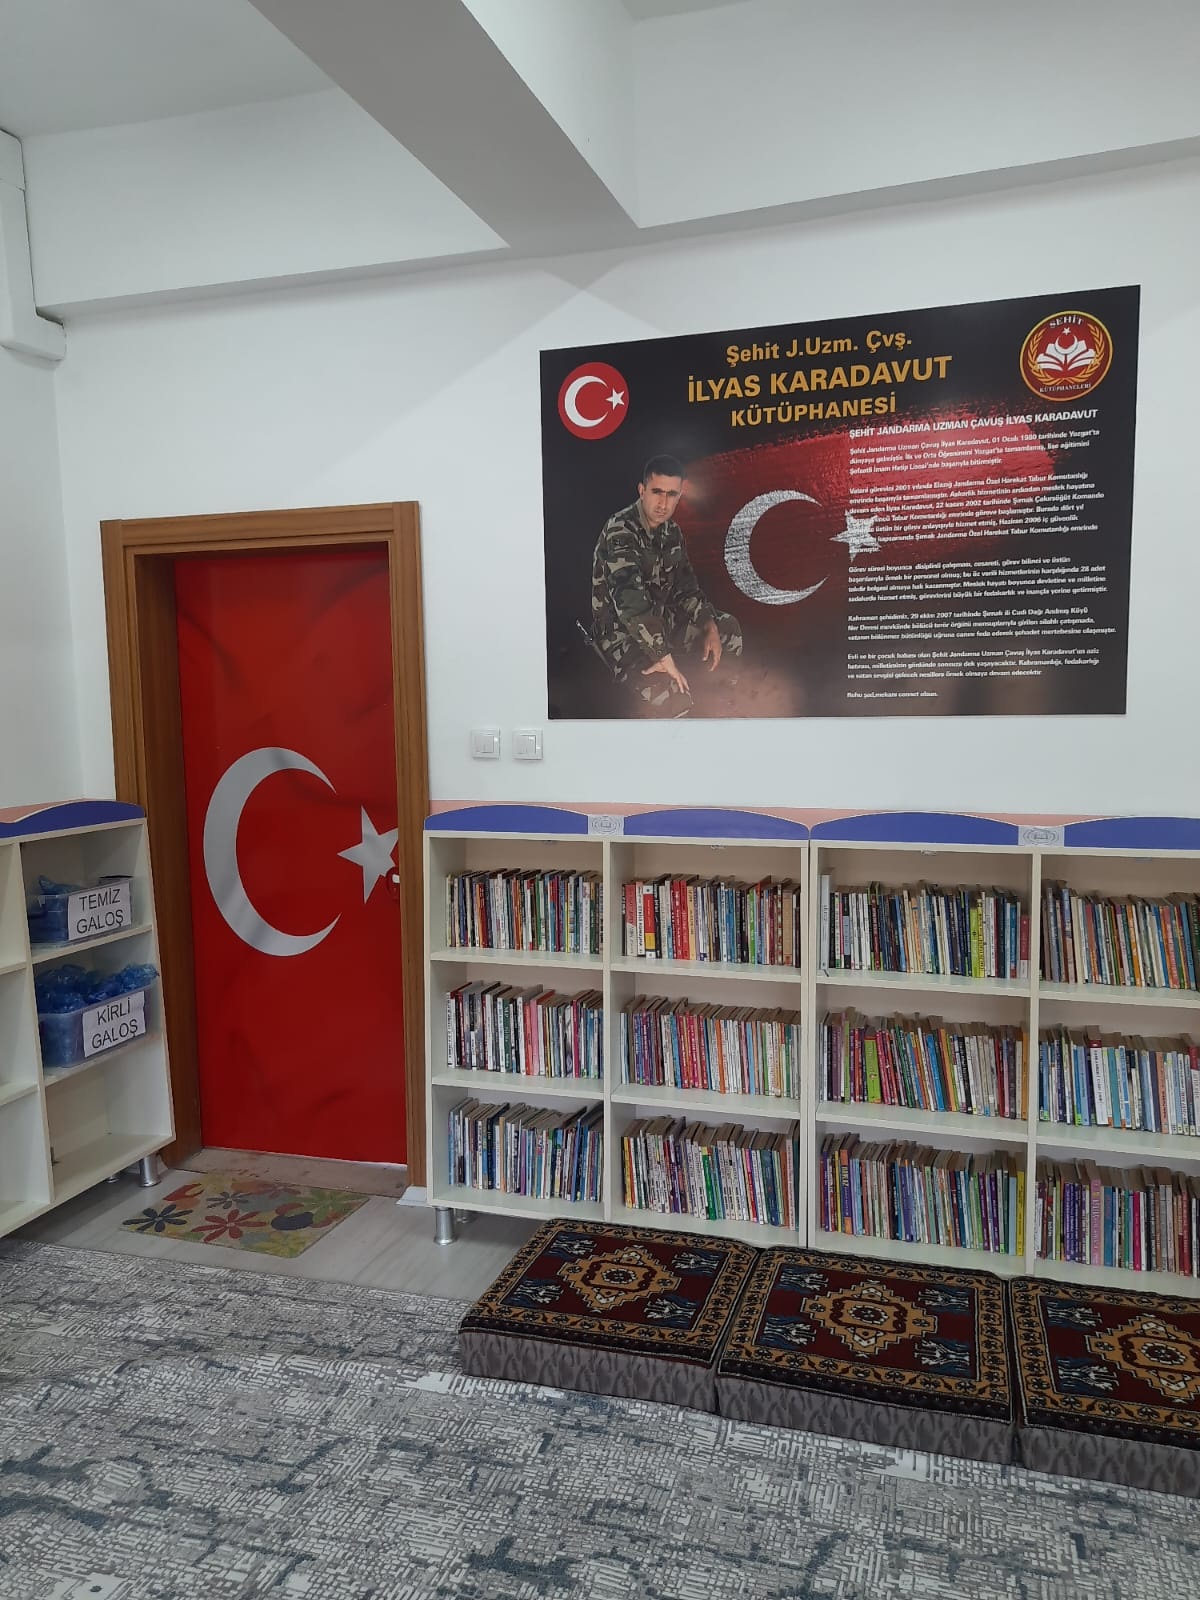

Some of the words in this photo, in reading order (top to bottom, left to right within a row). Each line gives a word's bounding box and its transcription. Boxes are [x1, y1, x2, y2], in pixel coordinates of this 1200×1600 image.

[1050, 315, 1083, 328] ŞEHİT
[726, 342, 780, 367] Şehit
[786, 337, 858, 358] J.Uzm.
[866, 330, 912, 353] Çvş.
[688, 376, 761, 403] İLYAS
[770, 355, 952, 395] KARADAVUT
[731, 392, 897, 427] KÜTÜPHANESİ
[849, 426, 874, 439] ŞEHİT
[876, 422, 930, 435] JANDARMA
[932, 419, 968, 431] UZMAN
[970, 416, 1003, 430] ÇAVUŞ
[1005, 414, 1032, 425] İLYAS
[1034, 409, 1097, 423] KARADAVUT
[79, 889, 121, 912] TEMİZ
[76, 910, 124, 934] GALOŞ
[97, 997, 130, 1025] KİRLİ
[92, 1019, 138, 1049] GALOŞ
